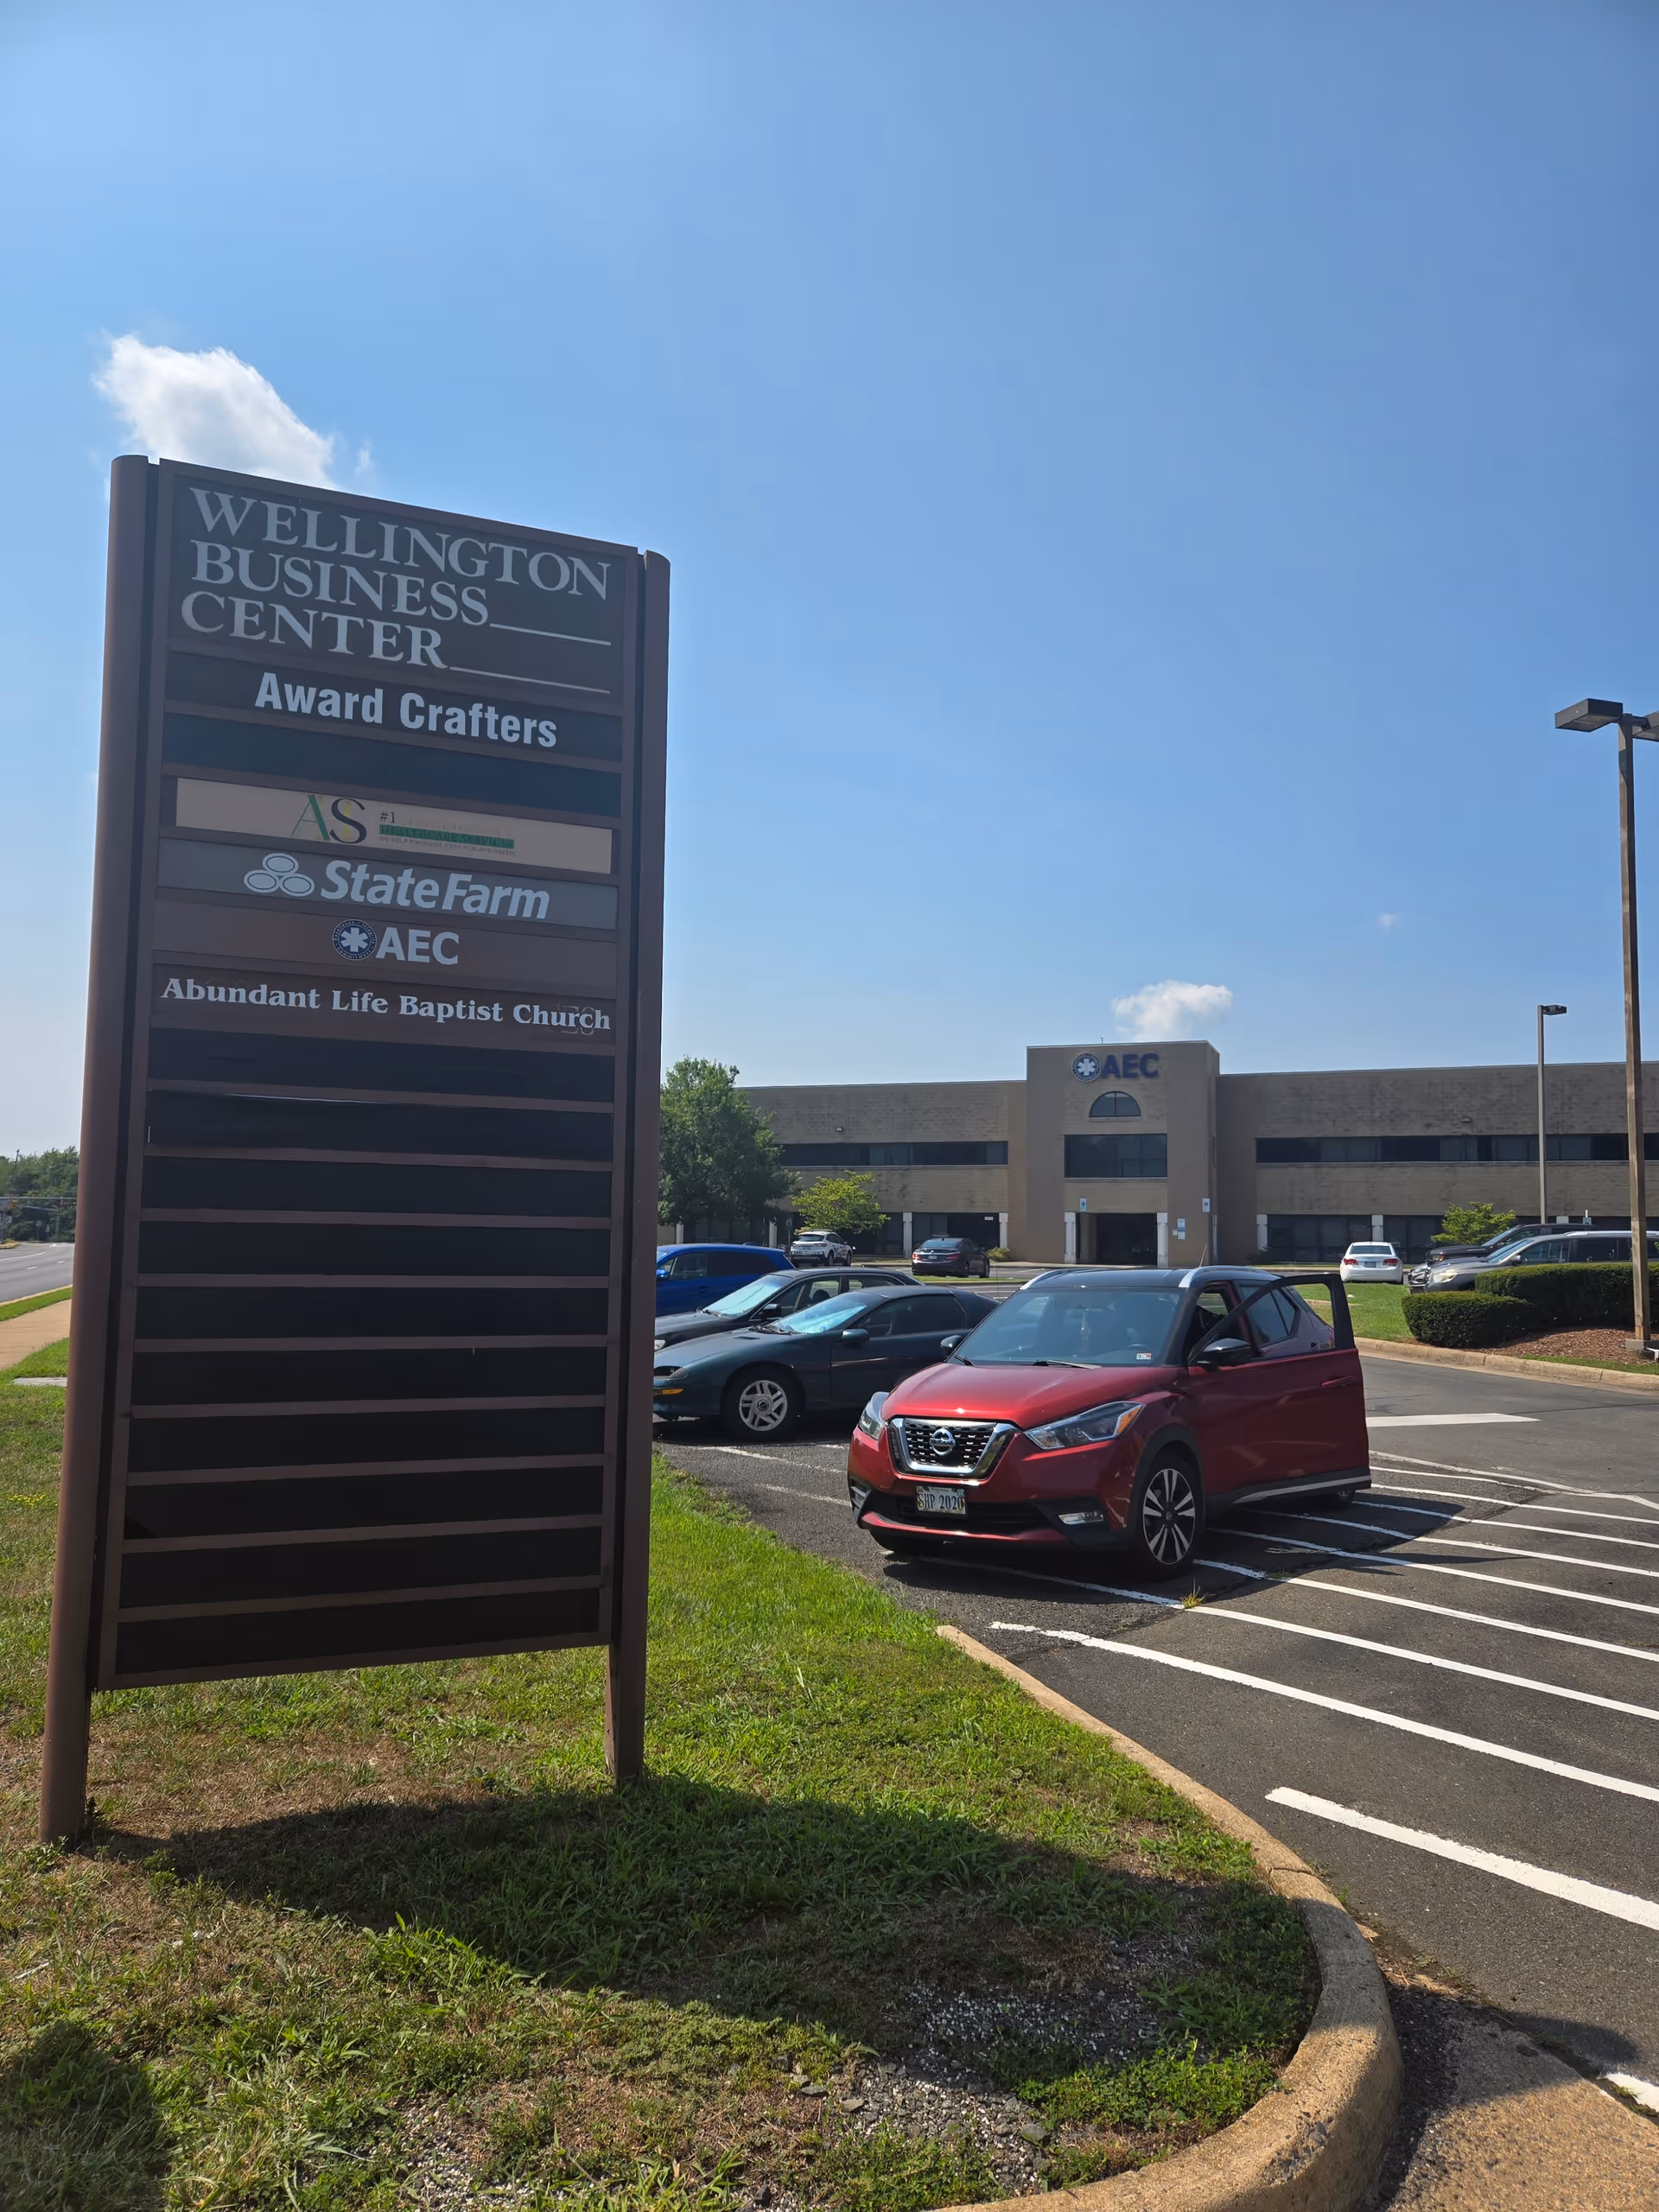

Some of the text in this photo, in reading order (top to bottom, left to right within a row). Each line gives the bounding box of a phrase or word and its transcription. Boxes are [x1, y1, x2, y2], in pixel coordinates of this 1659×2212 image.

[189, 487, 611, 601] WELLINGTON
[190, 539, 489, 626] BUSINESS
[181, 591, 448, 669] CENTER
[255, 671, 557, 748] Award Crafters
[290, 794, 367, 844] AS
[379, 810, 397, 823] #1
[375, 927, 460, 965] AEC
[161, 978, 611, 1030] Abundant Life Baptist Church
[1101, 1052, 1160, 1079] AEC
[918, 1493, 963, 1510] SHP 2020
